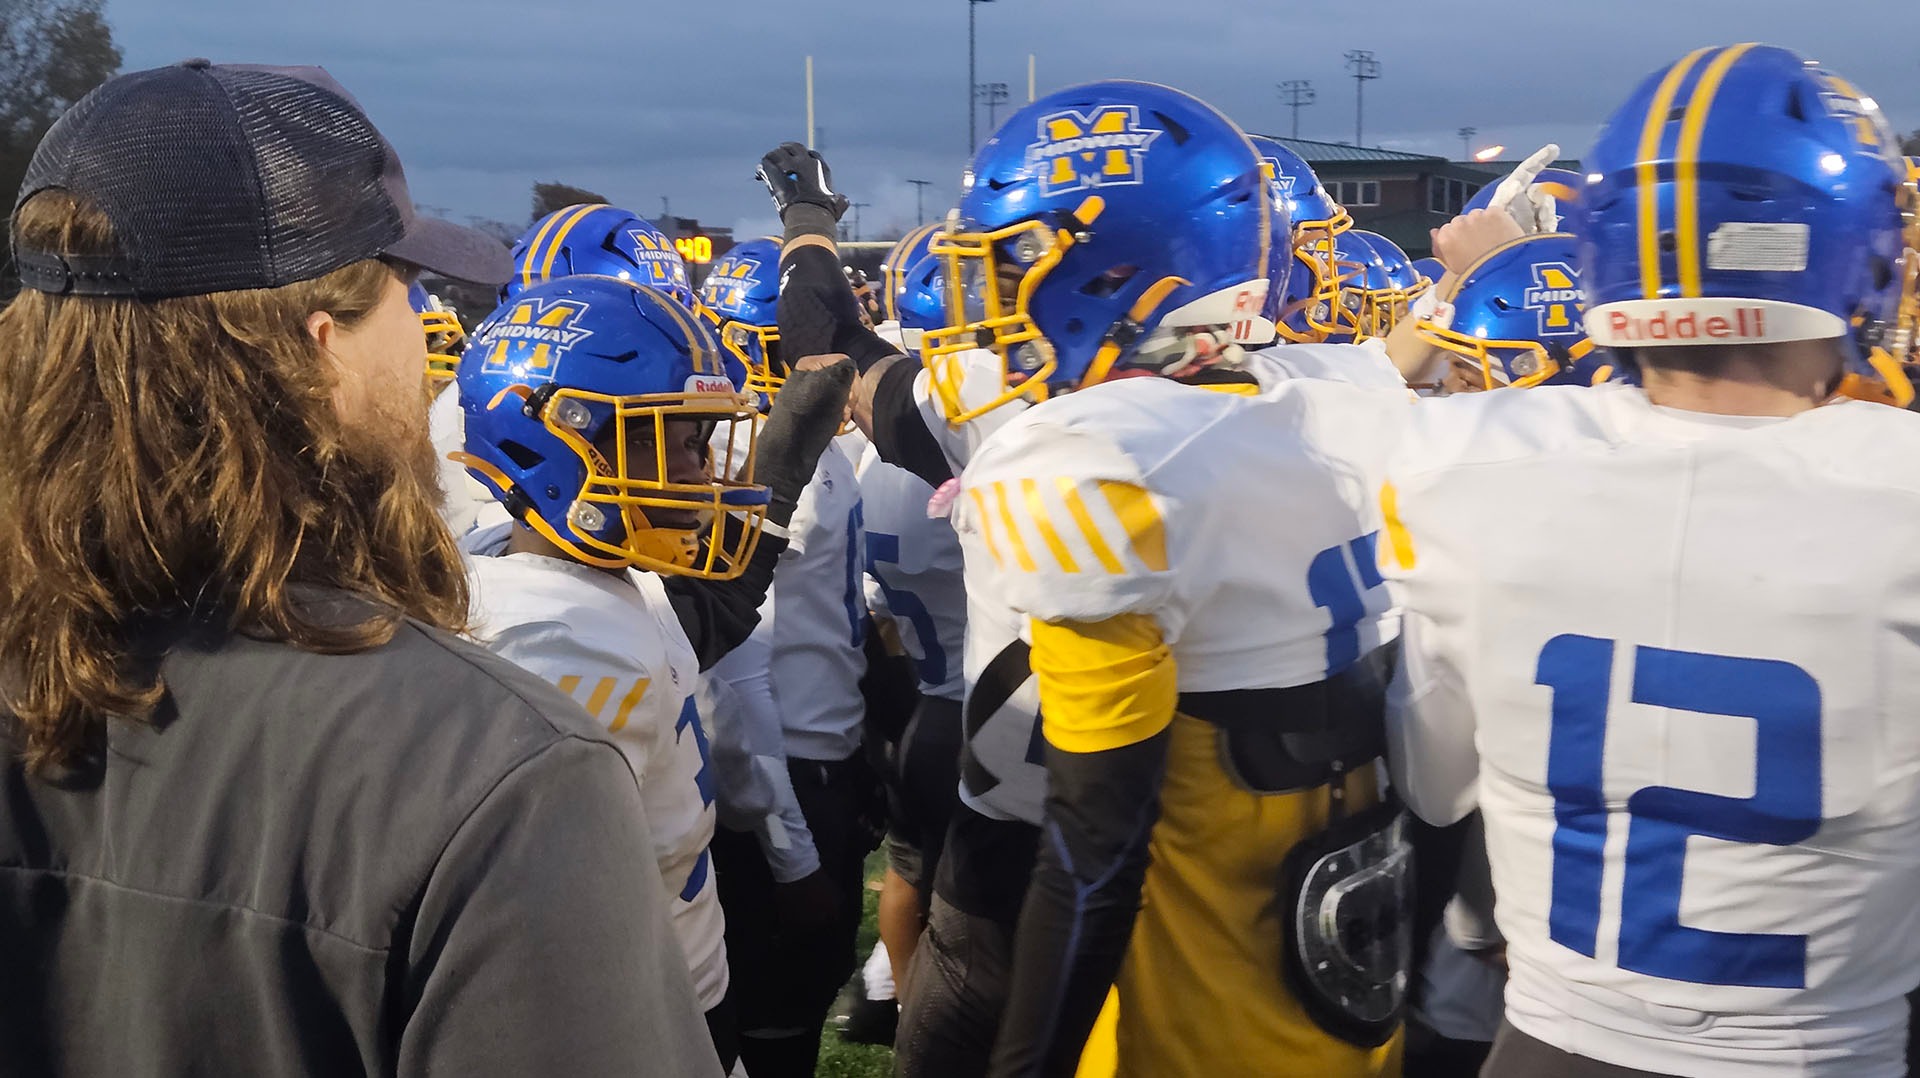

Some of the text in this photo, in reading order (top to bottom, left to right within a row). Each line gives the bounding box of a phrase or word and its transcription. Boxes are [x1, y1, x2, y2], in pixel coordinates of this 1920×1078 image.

[1031, 134, 1148, 160] MIDWAY
[675, 236, 712, 263] 40
[1531, 290, 1585, 303] MID
[490, 326, 578, 343] MIDWAY
[1609, 307, 1767, 340] Riddell
[696, 380, 732, 393] Ridd
[1534, 633, 1824, 989] 12
